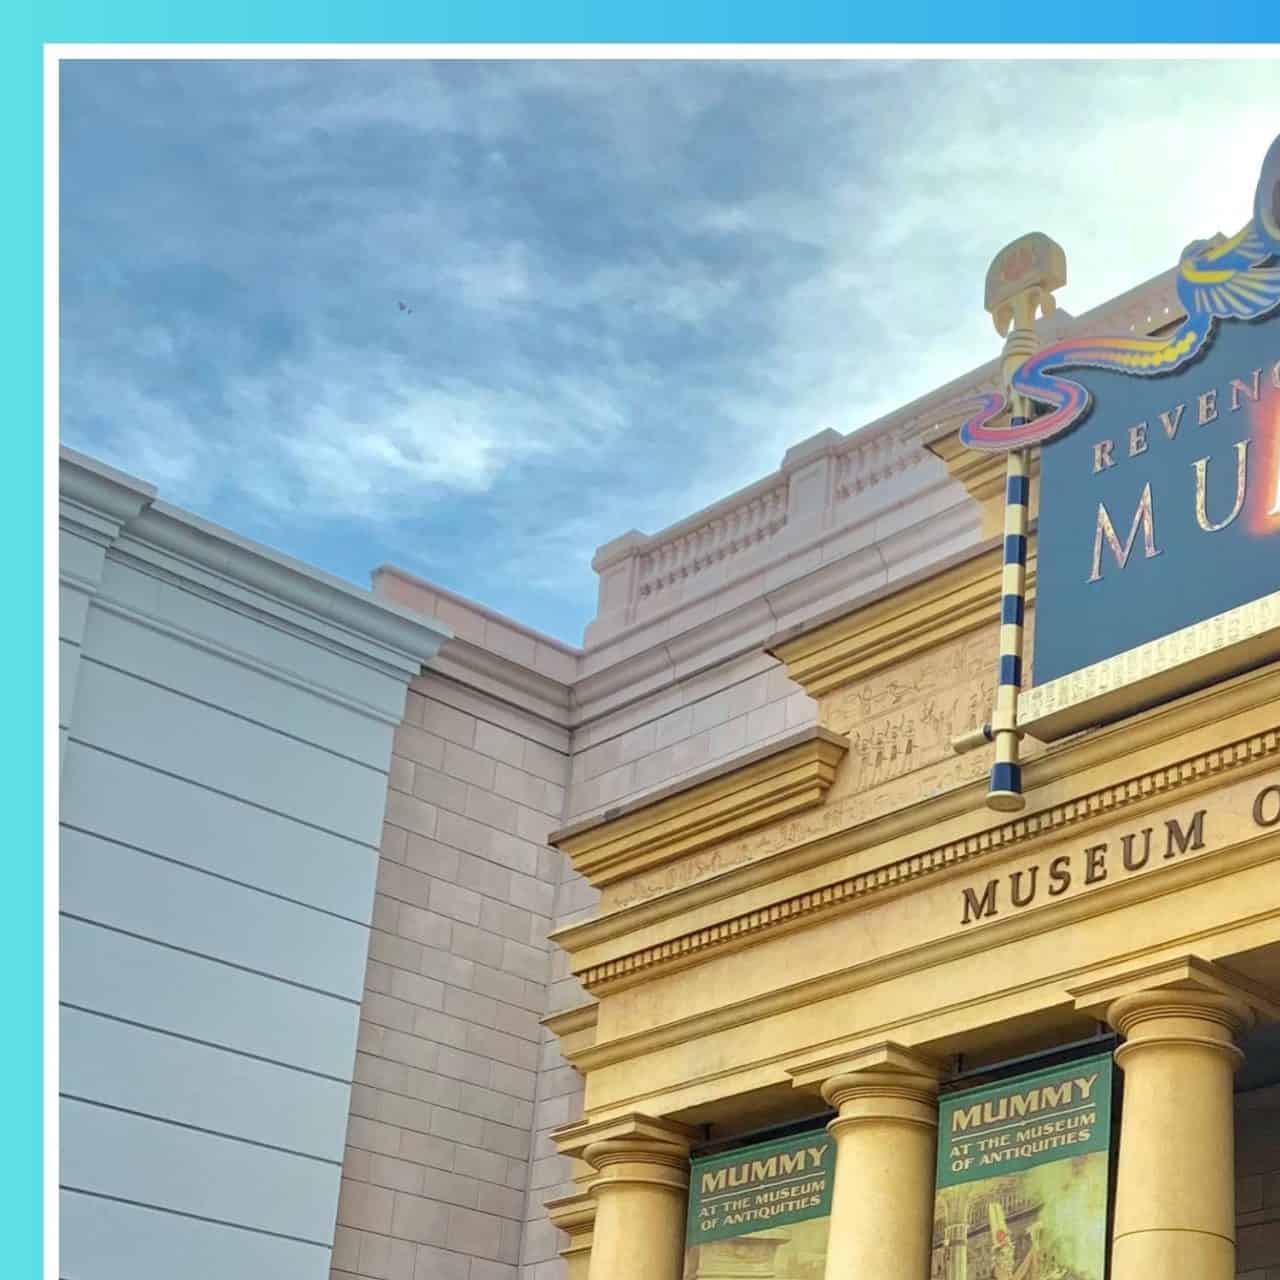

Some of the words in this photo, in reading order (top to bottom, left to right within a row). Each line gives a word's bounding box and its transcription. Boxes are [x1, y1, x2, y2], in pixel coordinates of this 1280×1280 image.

[959, 808, 1207, 924] MUSEUM
[952, 1073, 1098, 1132] MUMMY
[950, 1143, 973, 1158] AT
[976, 1134, 1011, 1152] THE
[1016, 1112, 1096, 1142] MUSEUM
[951, 1157, 975, 1172] OF
[980, 1129, 1091, 1165] ANTIQUITIES
[702, 1144, 828, 1193] MUMMY
[699, 1204, 719, 1217] AT
[721, 1197, 751, 1212] THE
[755, 1180, 825, 1205] MUSEUM
[701, 1218, 721, 1231] OF
[723, 1195, 821, 1225] ANTIQUITIES
